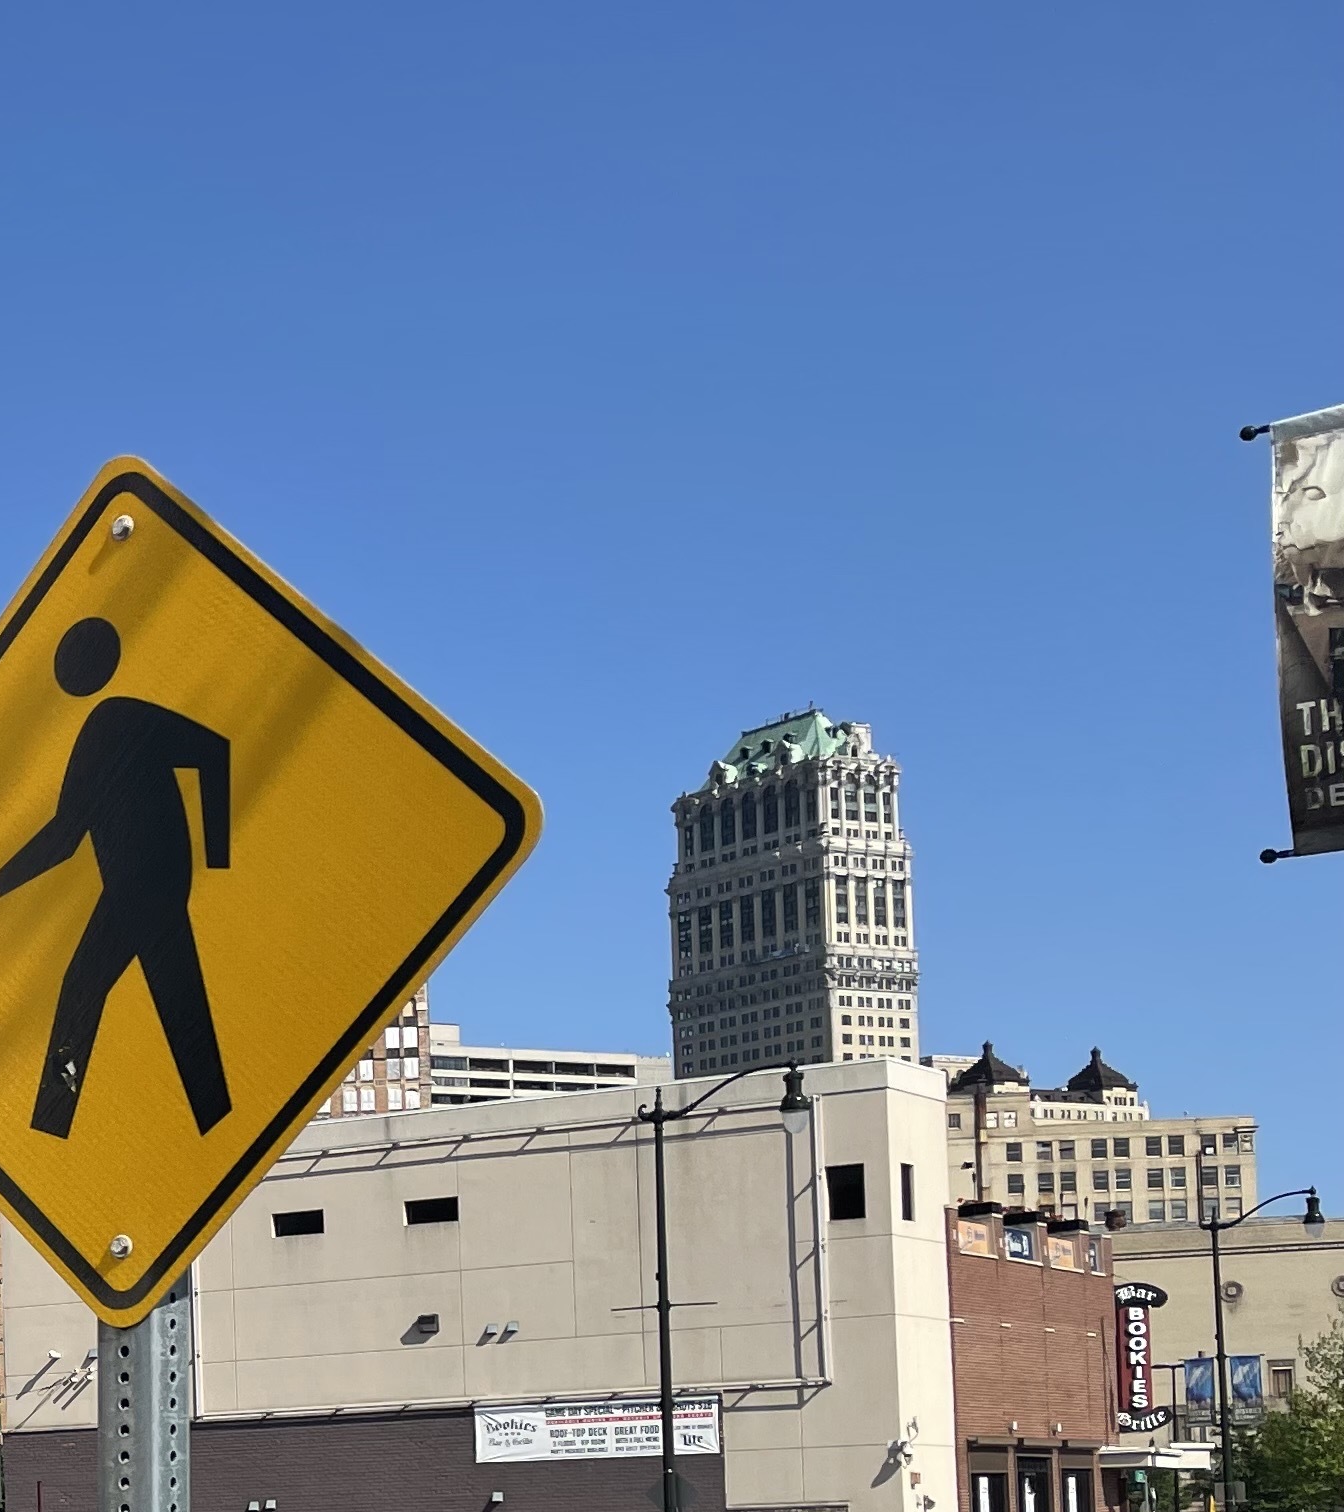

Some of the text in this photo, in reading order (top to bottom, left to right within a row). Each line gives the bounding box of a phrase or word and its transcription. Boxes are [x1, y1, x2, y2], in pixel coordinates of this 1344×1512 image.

[1116, 1285, 1157, 1304] Bar
[1128, 1306, 1149, 1409] BOOKIES
[588, 1426, 608, 1437] DECK
[614, 1424, 660, 1436] GREAT FOOD
